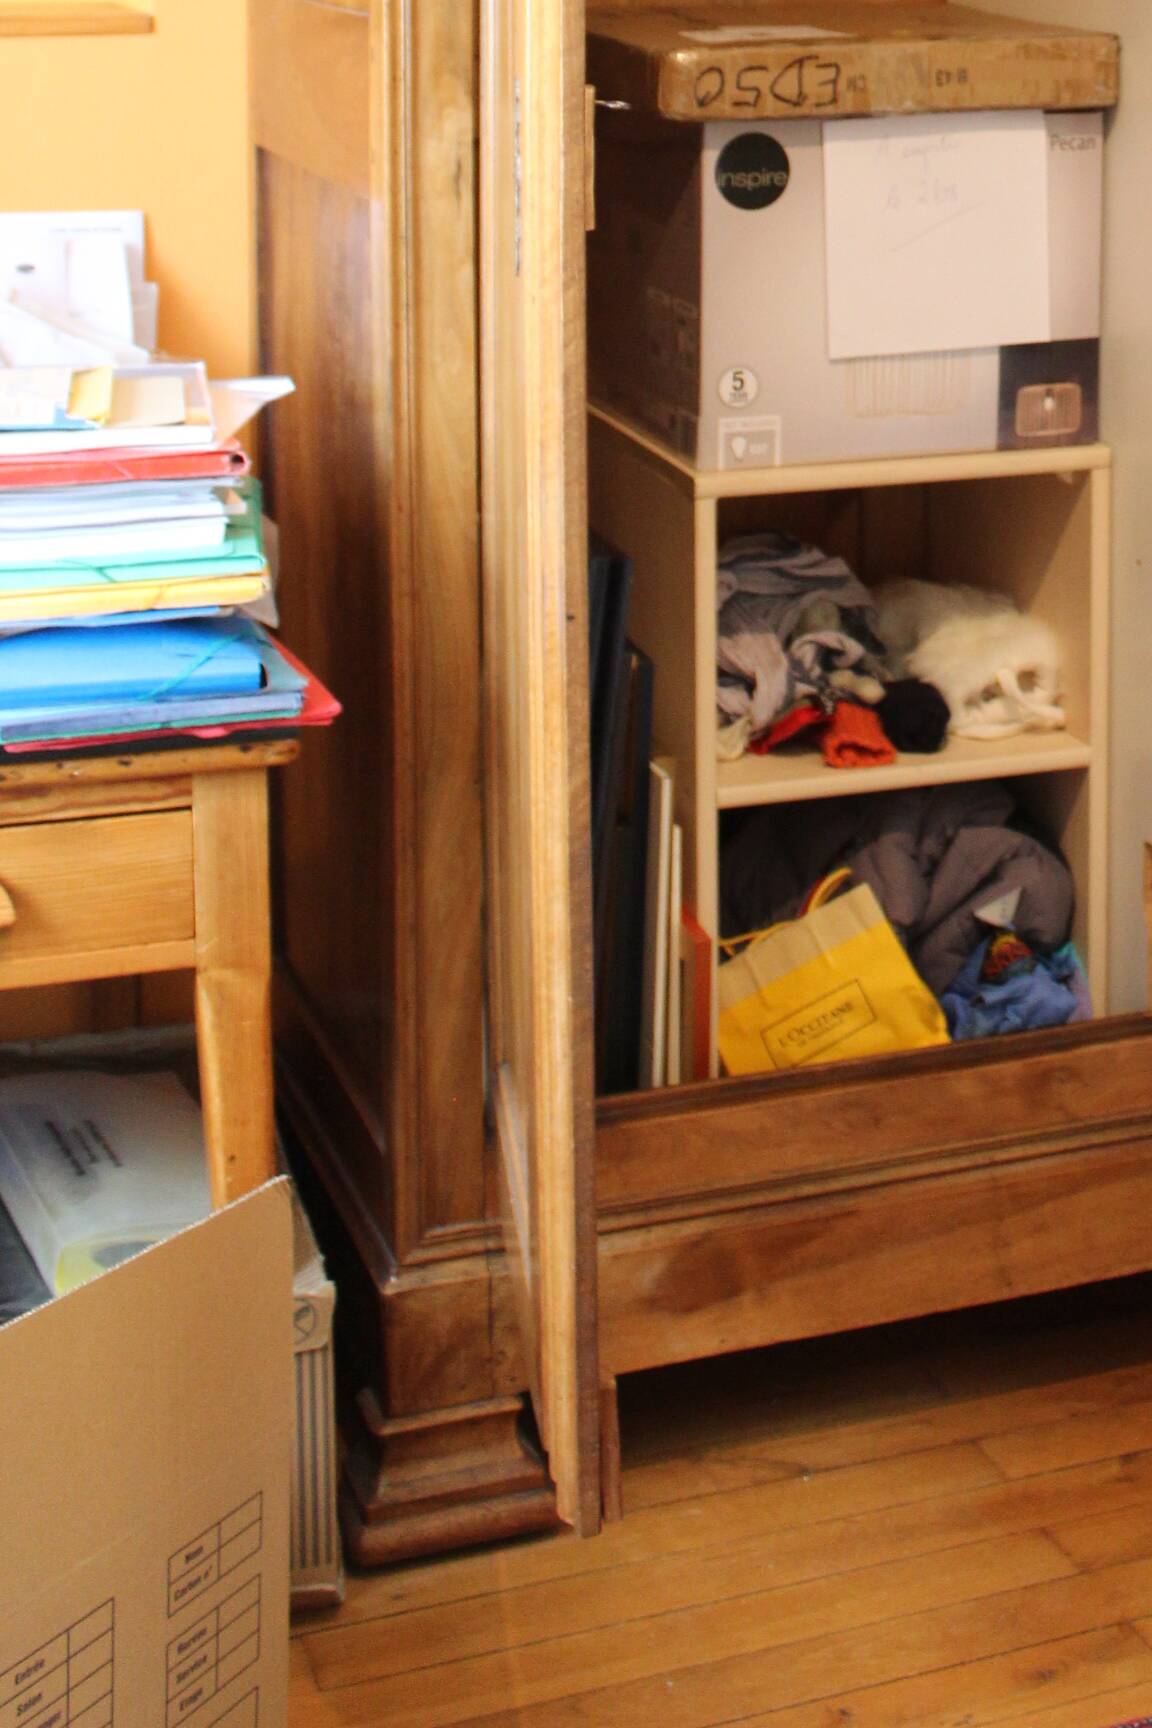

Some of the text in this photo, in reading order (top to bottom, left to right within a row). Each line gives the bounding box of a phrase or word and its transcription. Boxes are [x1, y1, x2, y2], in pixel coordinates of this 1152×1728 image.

[1050, 134, 1096, 151] Pecan
[717, 167, 788, 190] inspire
[732, 370, 745, 391] 5
